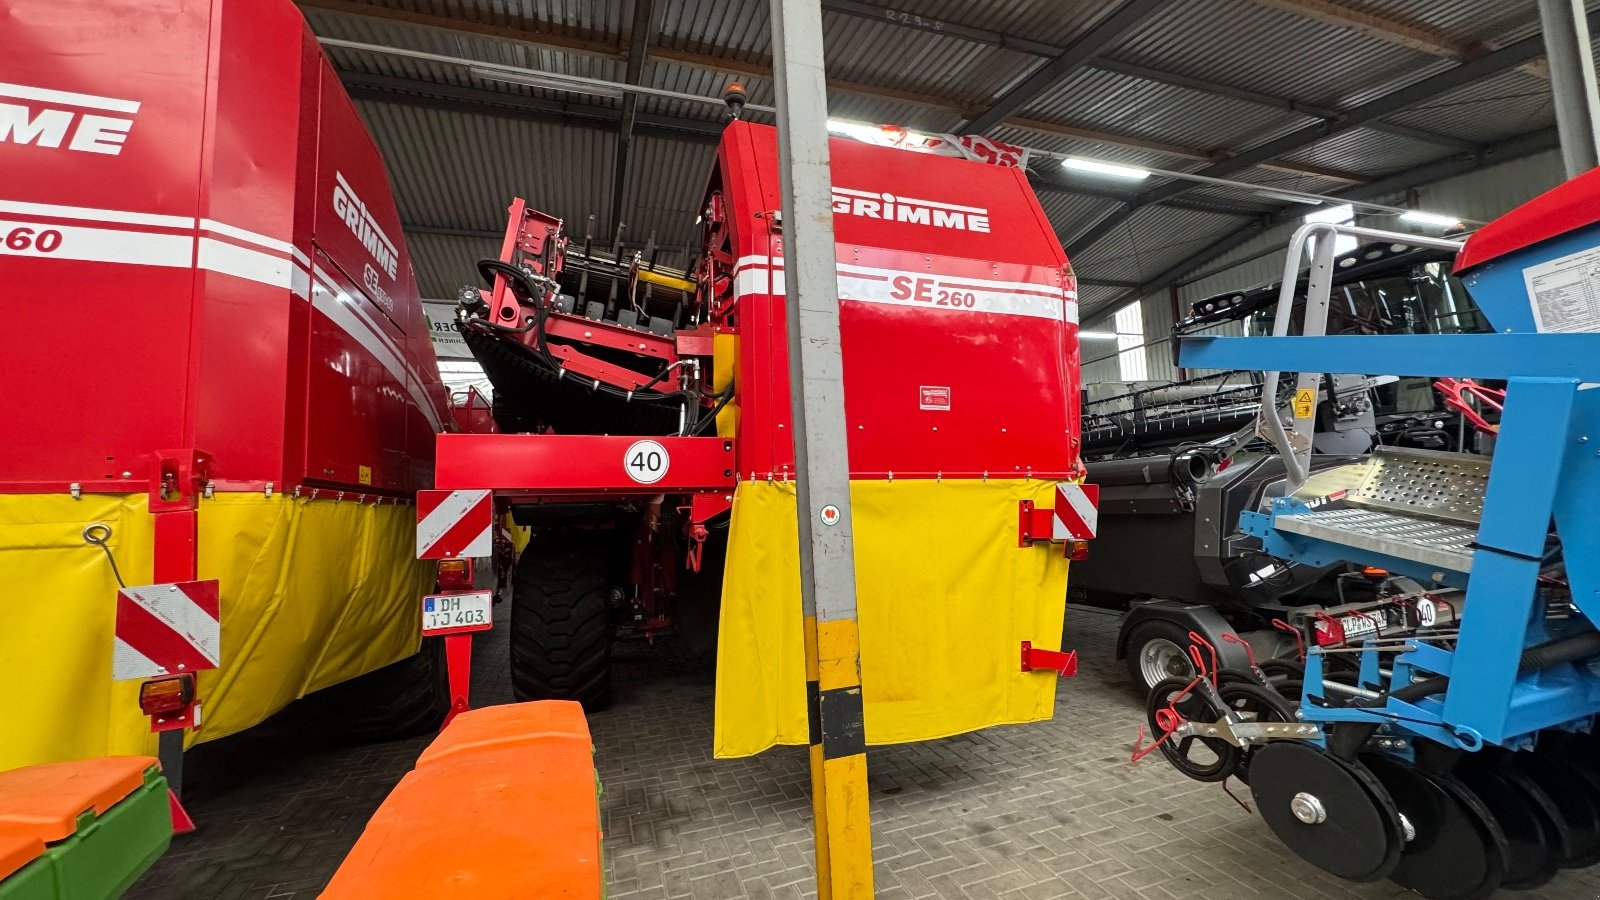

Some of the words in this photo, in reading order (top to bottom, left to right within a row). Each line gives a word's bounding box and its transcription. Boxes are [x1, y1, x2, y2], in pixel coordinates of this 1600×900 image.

[0, 227, 62, 253] 60
[333, 186, 398, 282] GRIMME
[890, 275, 935, 303] SE
[936, 290, 976, 308] 260
[630, 451, 662, 472] 40
[440, 597, 460, 612] DH
[1420, 603, 1433, 623] 40
[455, 609, 484, 624] 403
